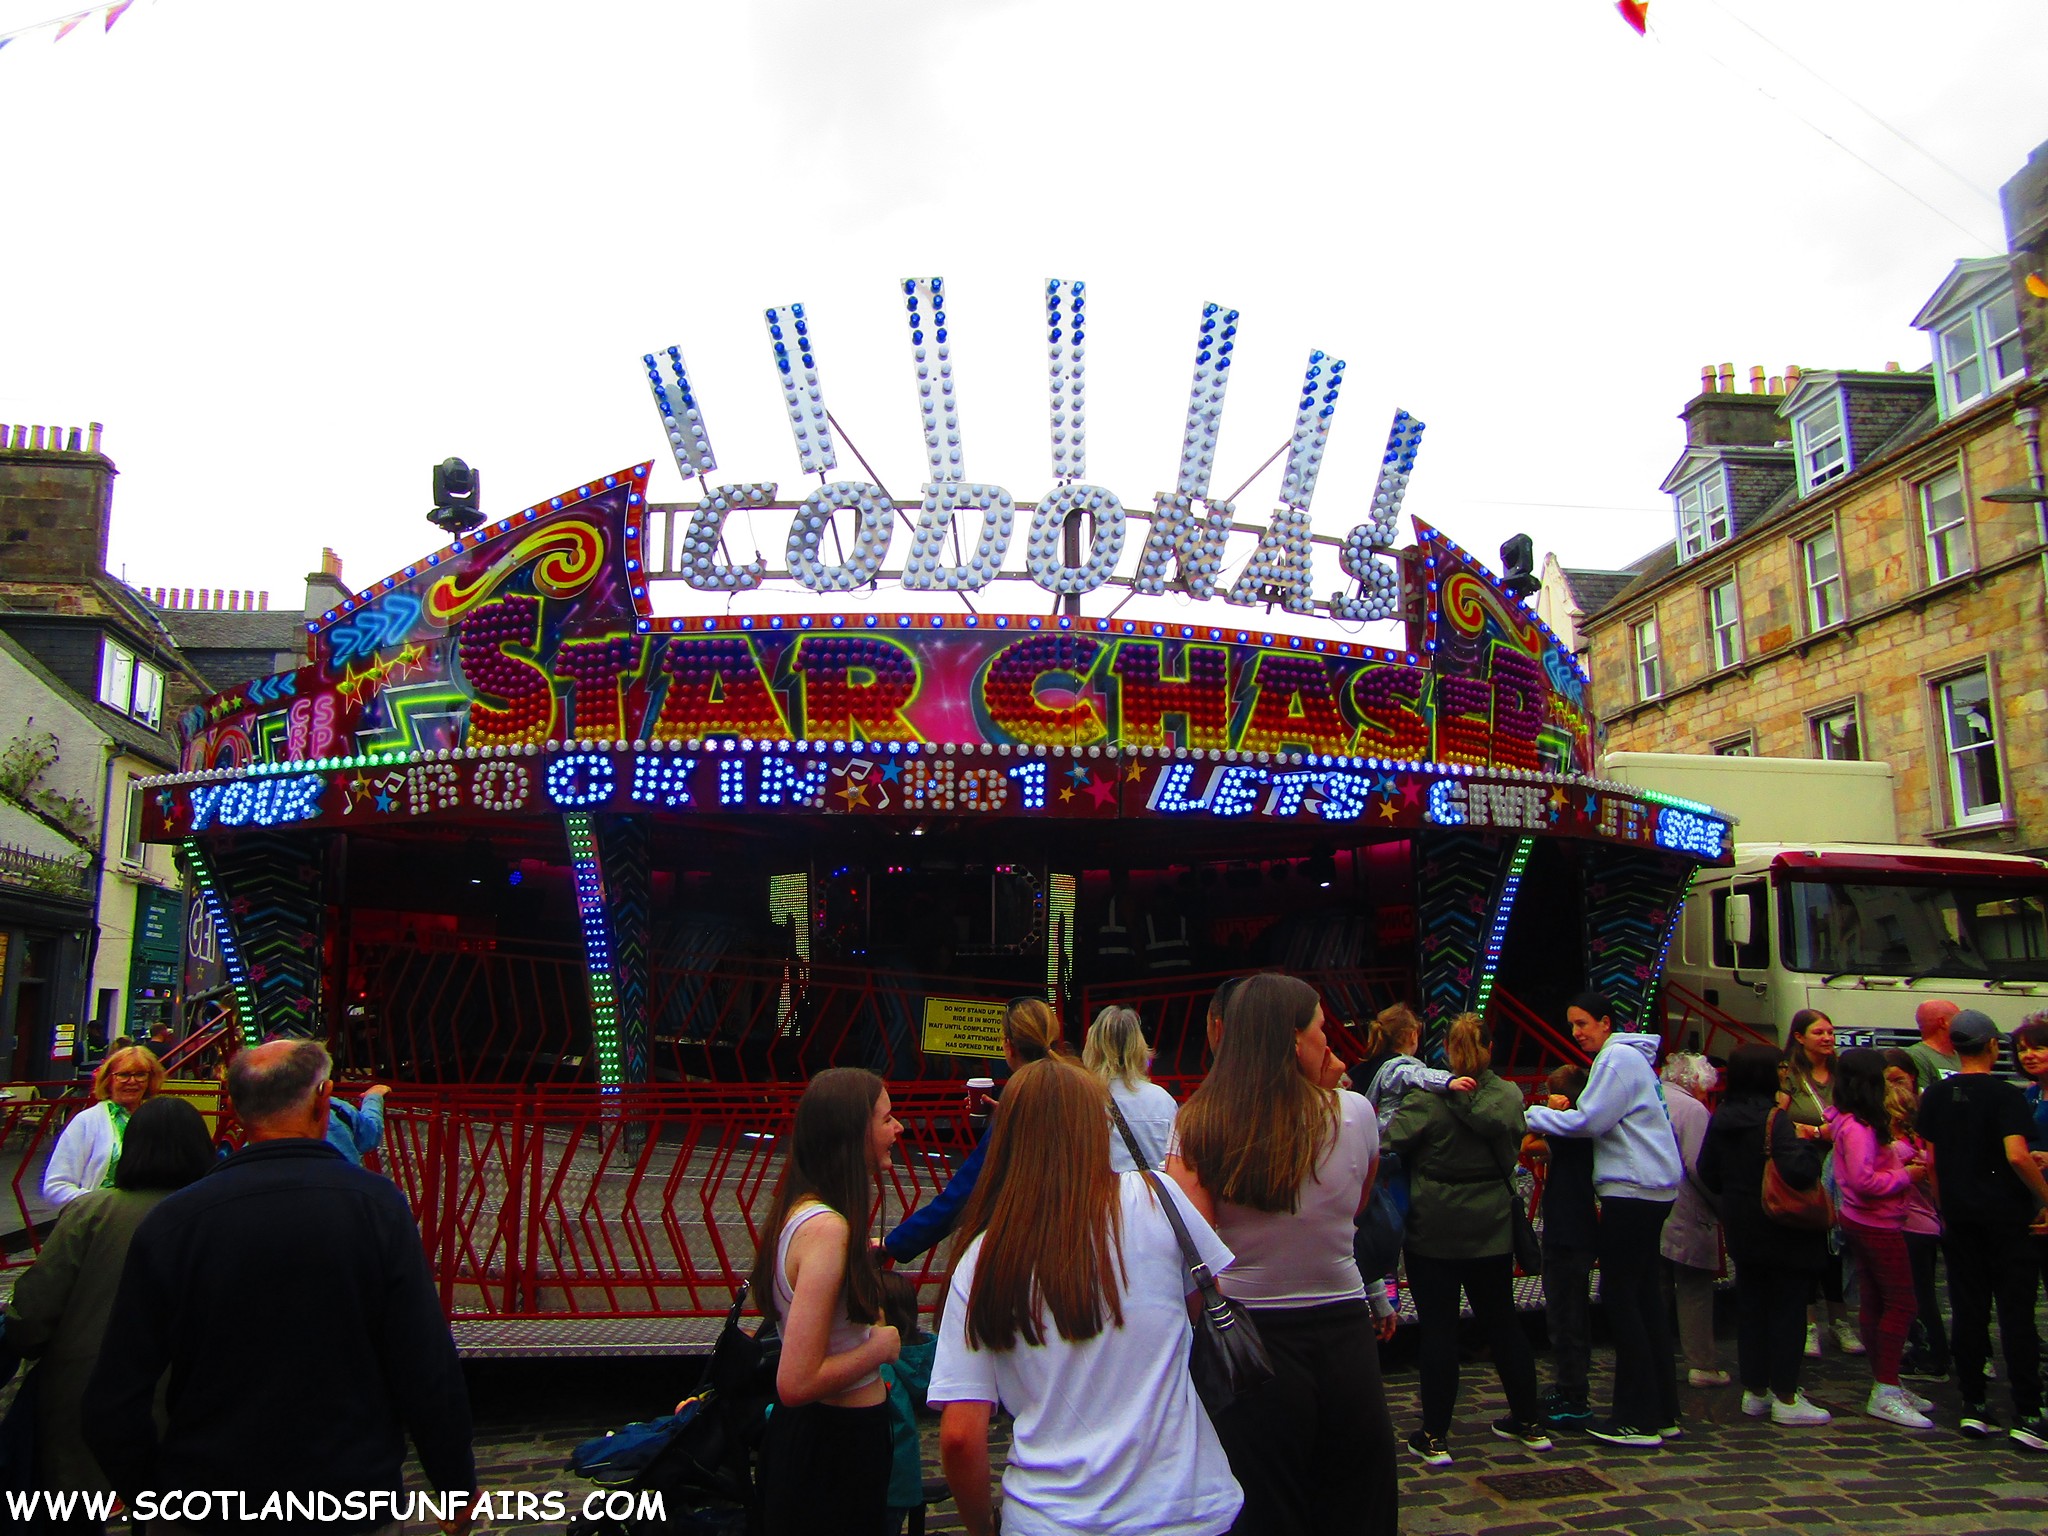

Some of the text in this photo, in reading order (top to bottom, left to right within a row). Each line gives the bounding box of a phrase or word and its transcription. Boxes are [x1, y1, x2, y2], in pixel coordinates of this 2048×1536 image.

[680, 481, 1402, 620] CODONAS
[459, 592, 1543, 772] STAR CHASER
[190, 773, 327, 831] YOUR
[1146, 763, 1372, 820] LETS
[967, 1007, 987, 1015] STAND
[963, 1025, 1001, 1033] COMPLETELY
[959, 1042, 982, 1050] OPENED
[1834, 1034, 1872, 1047] RF
